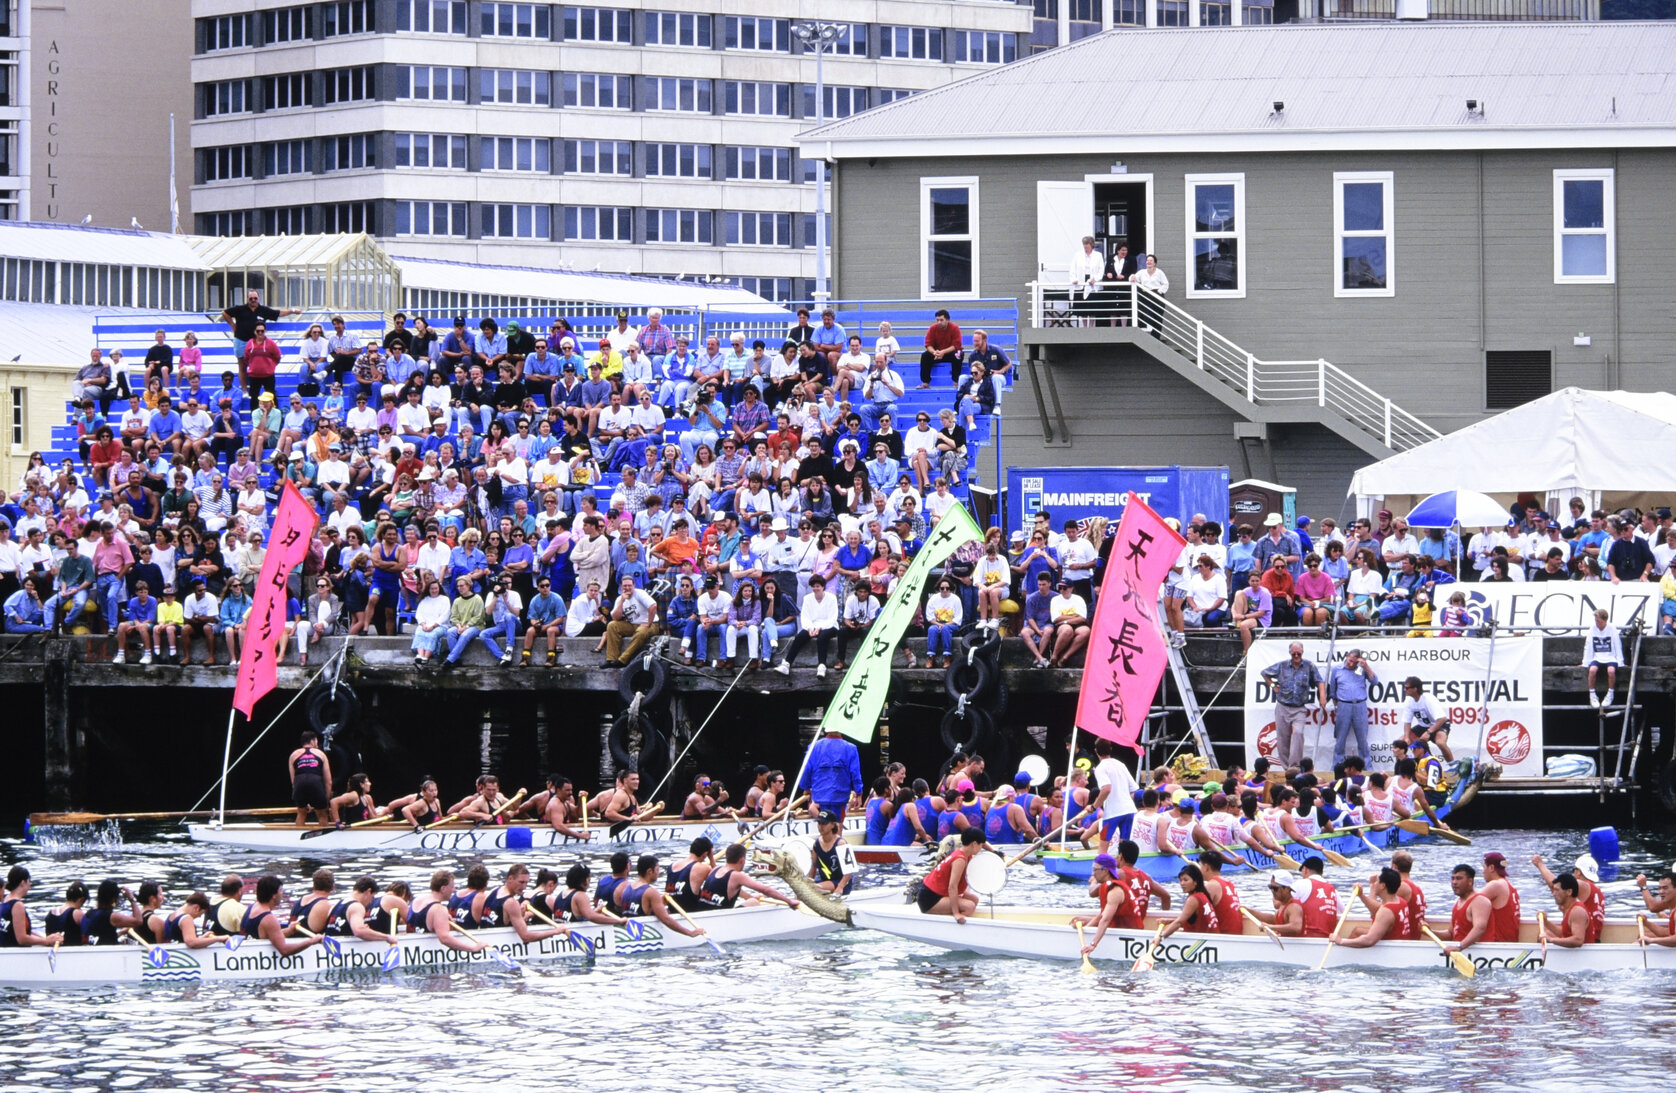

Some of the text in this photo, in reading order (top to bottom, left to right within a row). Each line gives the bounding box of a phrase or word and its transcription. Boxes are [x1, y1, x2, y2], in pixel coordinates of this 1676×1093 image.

[47, 40, 59, 220] AGRICULTU
[1316, 649, 1471, 663] LAMON HARBOUR
[1432, 768, 1440, 786] 5
[421, 832, 485, 850] CITY
[844, 847, 855, 869] 4
[213, 950, 305, 971] Lambton
[316, 947, 385, 968] Harbou
[1119, 937, 1218, 963] Telecom
